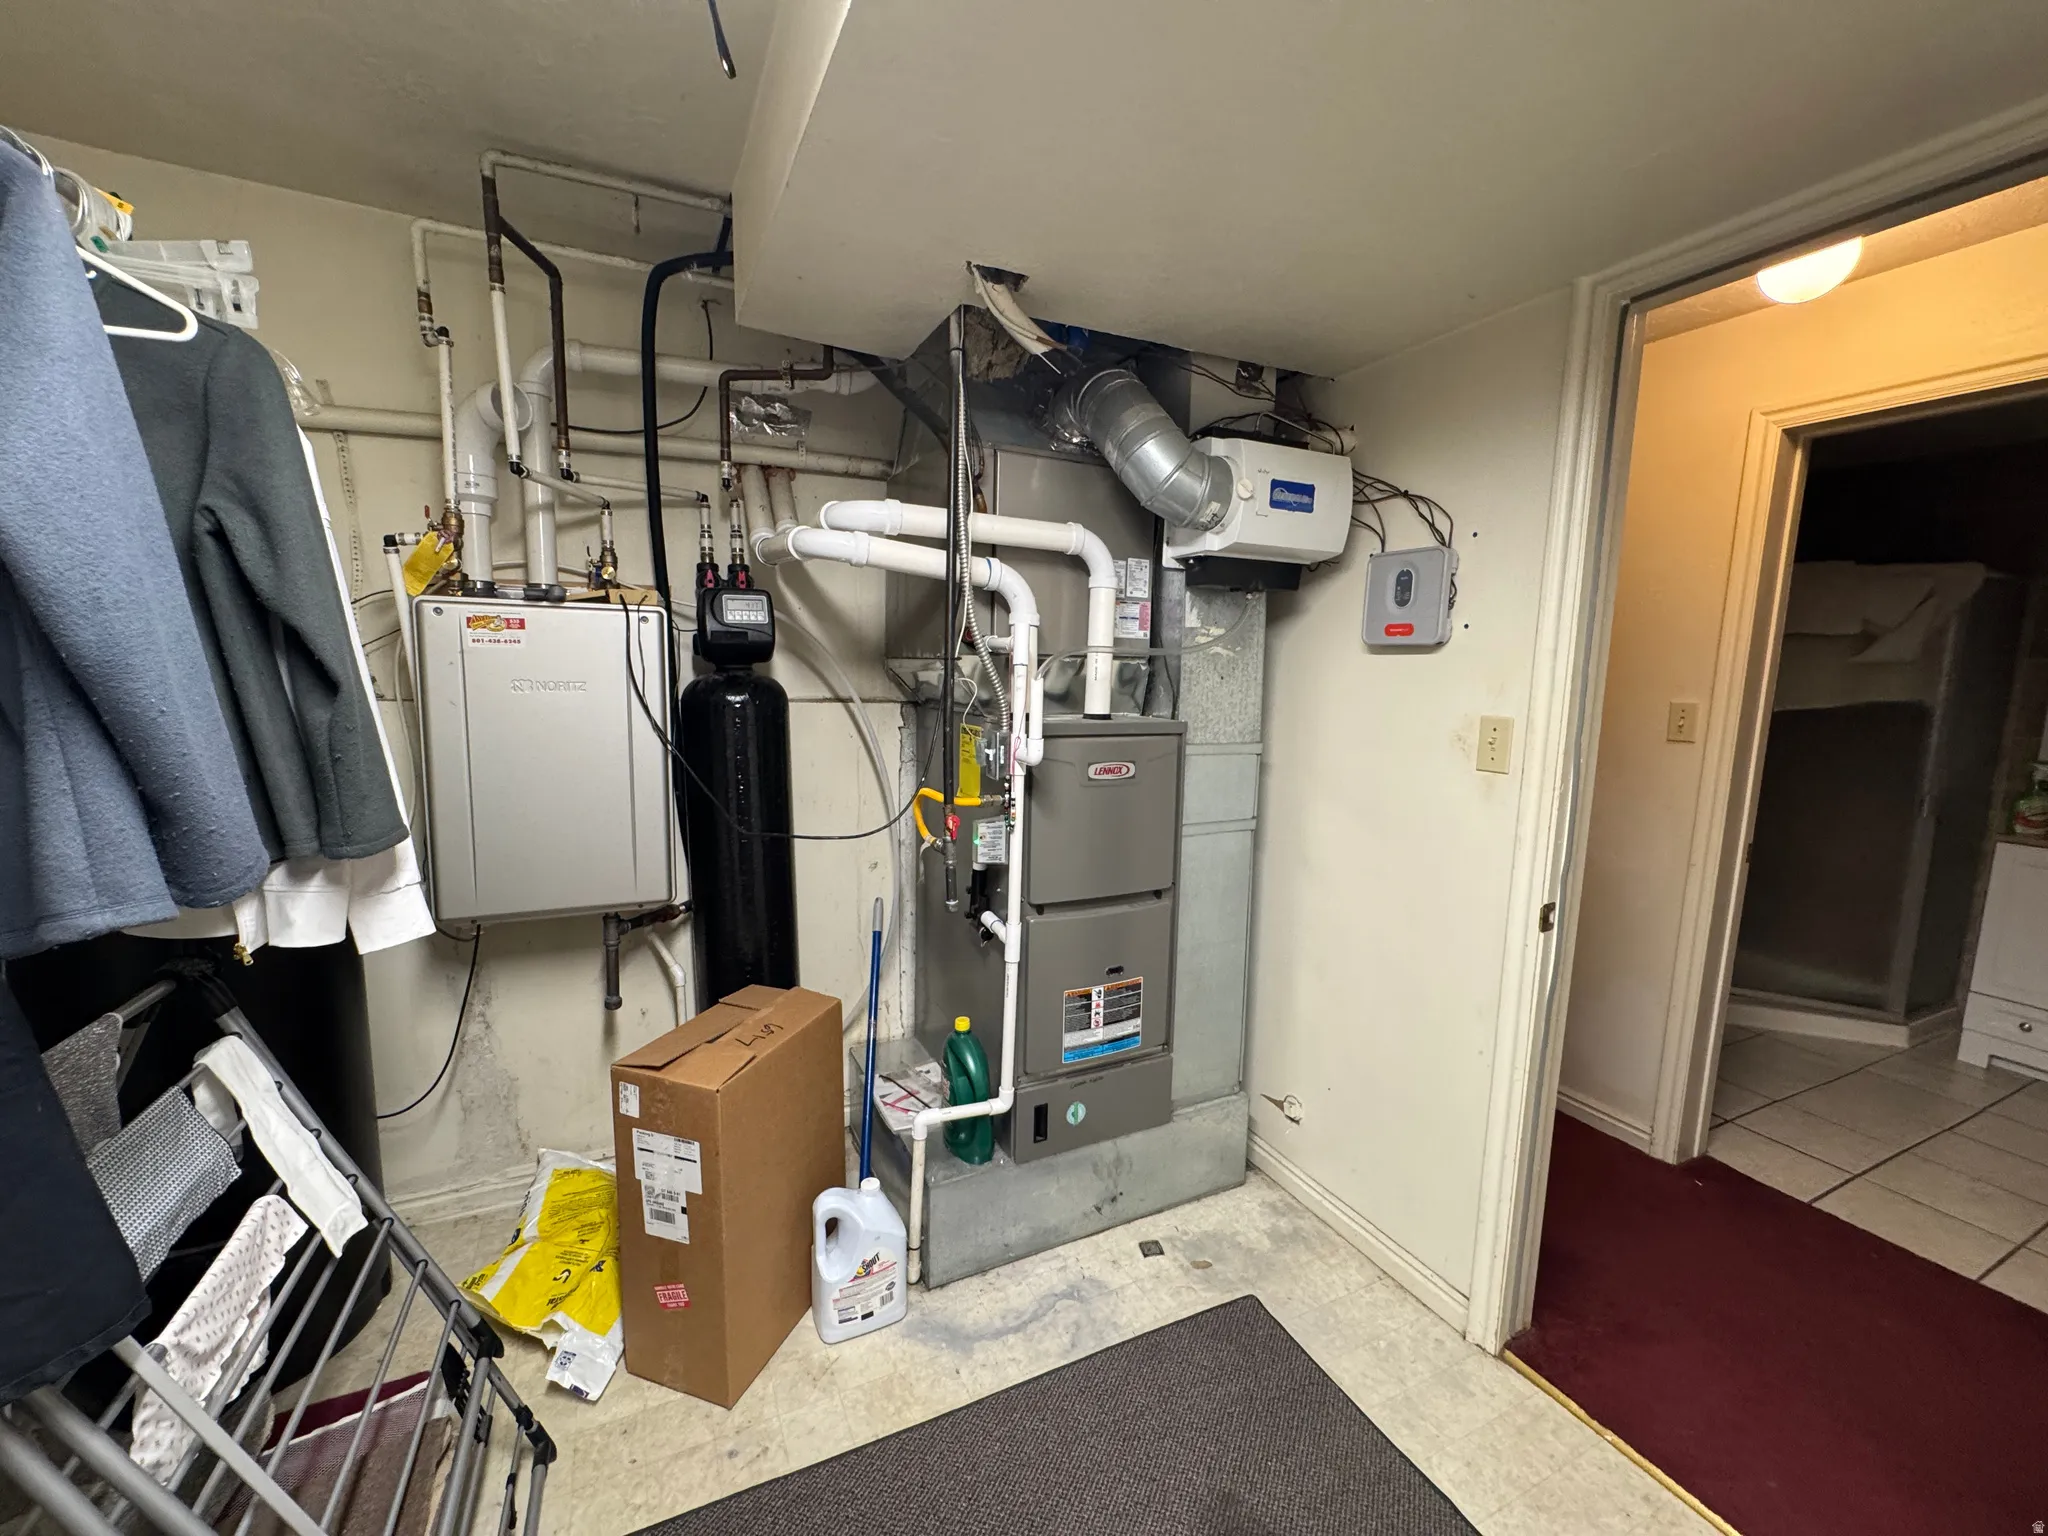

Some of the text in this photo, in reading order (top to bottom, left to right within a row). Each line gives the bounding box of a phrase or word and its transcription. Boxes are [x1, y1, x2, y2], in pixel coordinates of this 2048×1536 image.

[535, 680, 587, 692] NORITZ
[1094, 766, 1123, 776] LENNOX
[862, 1252, 880, 1273] SHOUT
[658, 1290, 688, 1302] FRAGILE
